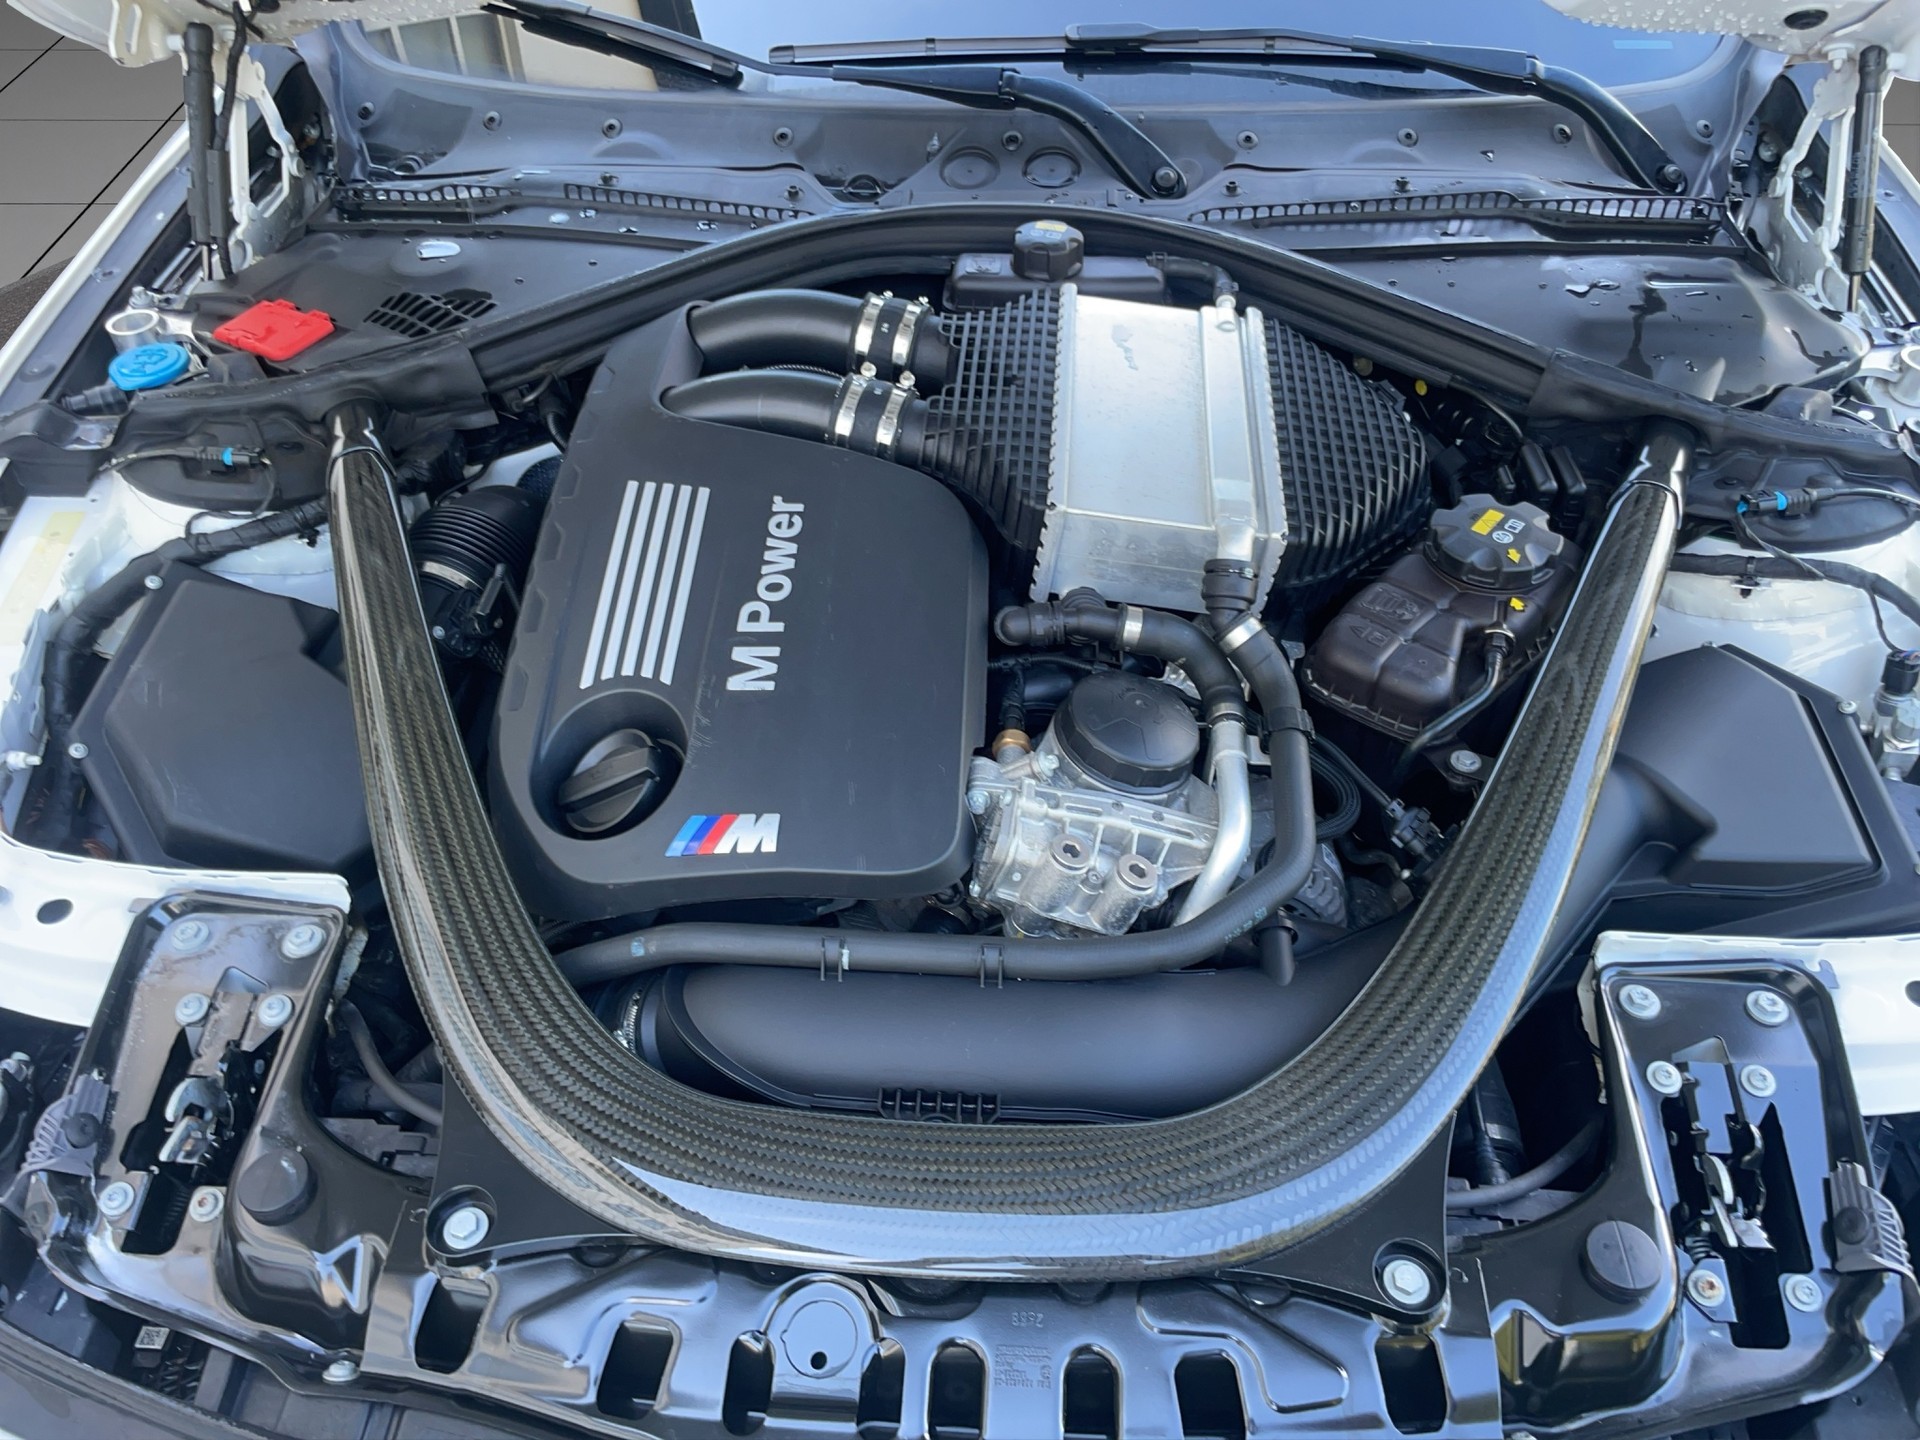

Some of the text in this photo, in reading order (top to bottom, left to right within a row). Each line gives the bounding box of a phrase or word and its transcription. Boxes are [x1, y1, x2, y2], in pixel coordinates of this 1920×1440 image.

[726, 495, 805, 691] M Power
[712, 813, 781, 854] M
